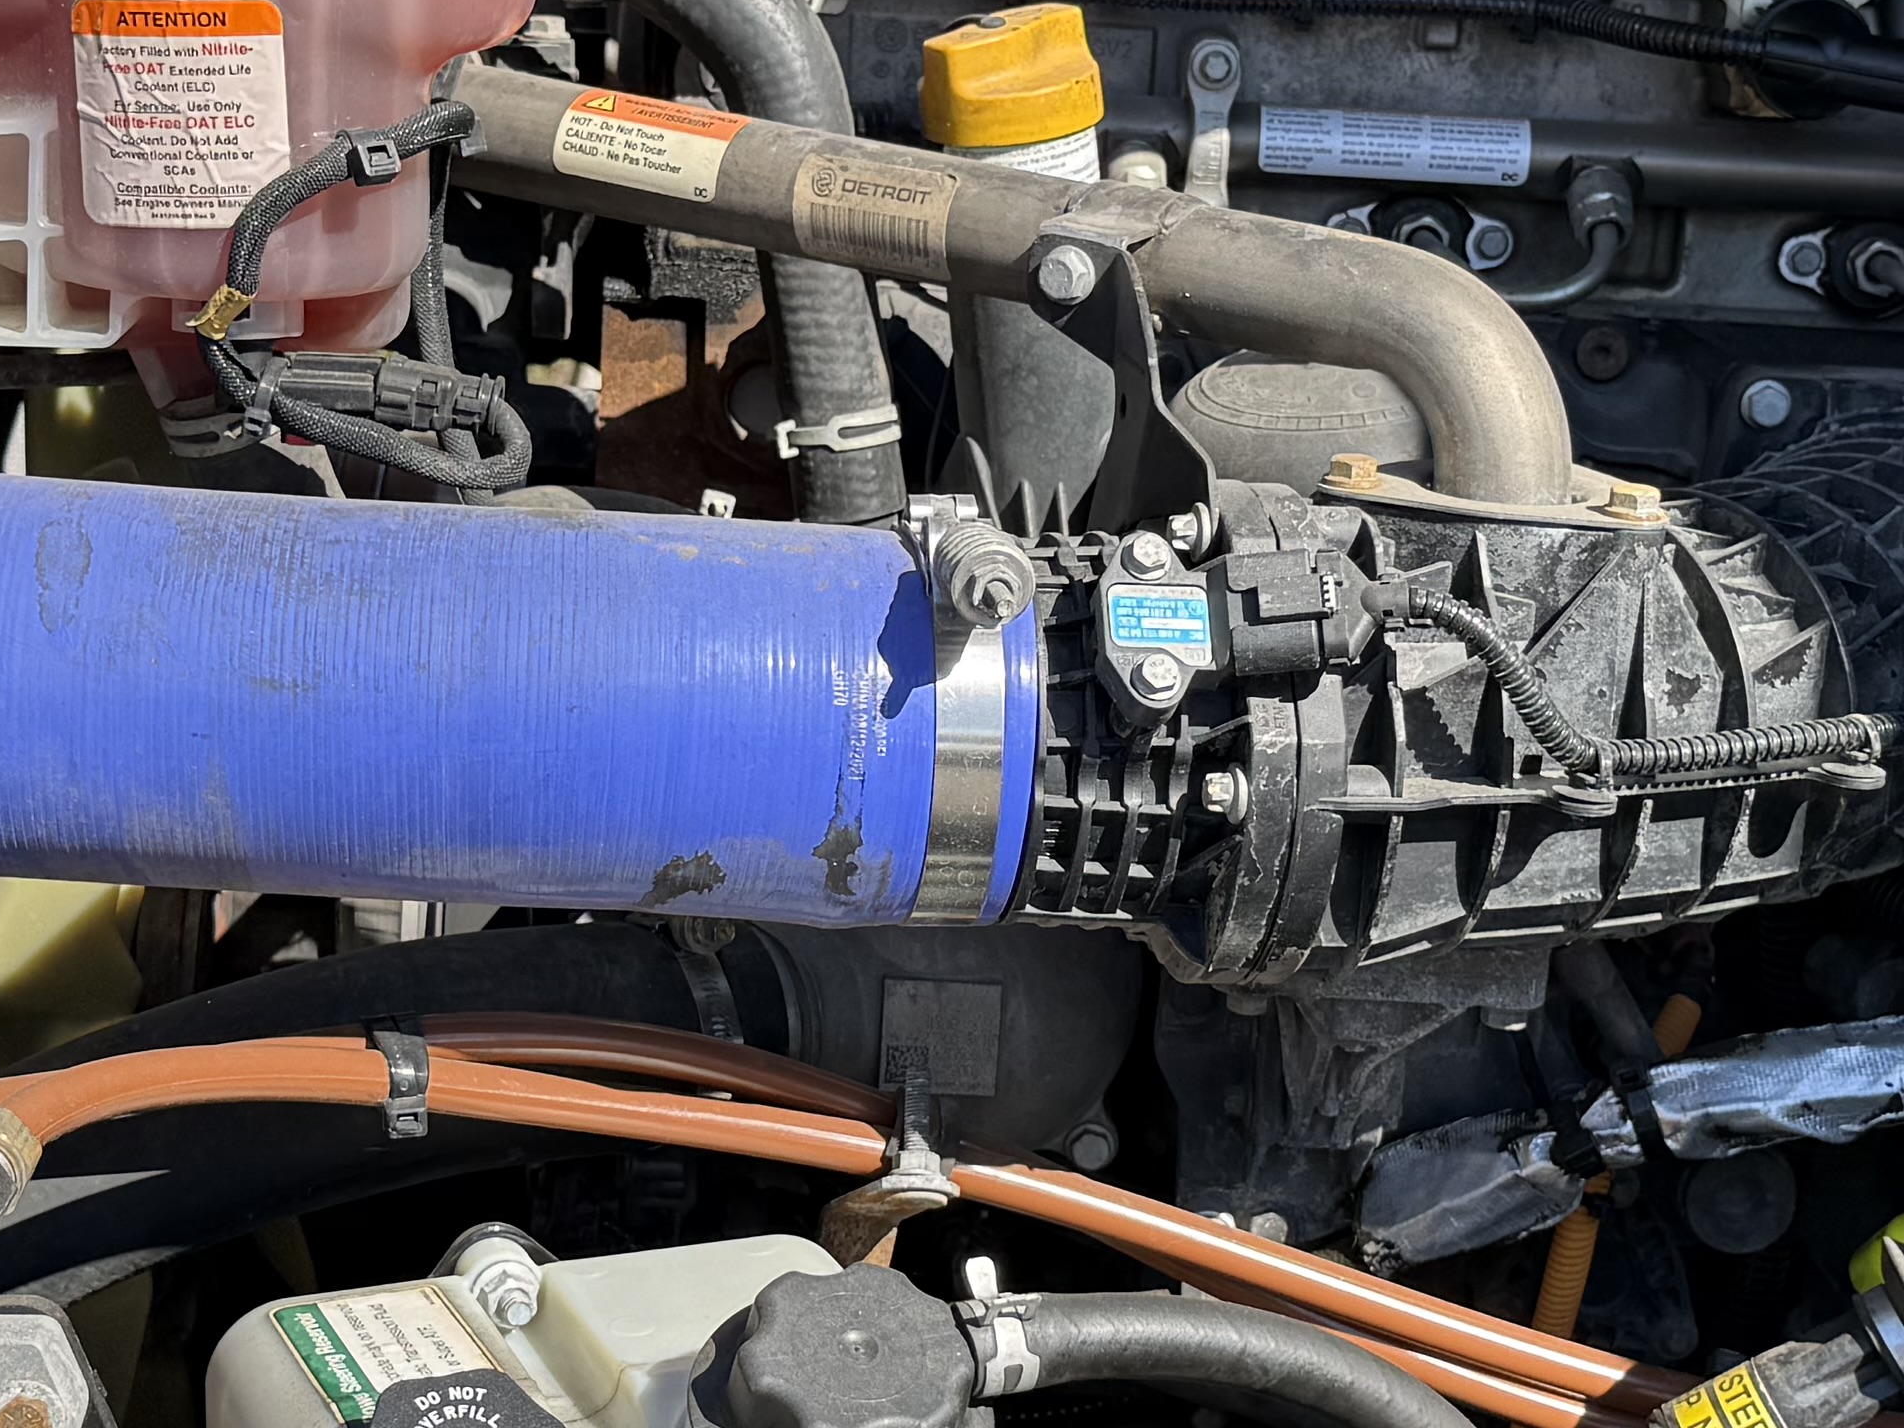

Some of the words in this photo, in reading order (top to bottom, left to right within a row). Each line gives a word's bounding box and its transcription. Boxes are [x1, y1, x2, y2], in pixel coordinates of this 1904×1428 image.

[117, 11, 227, 28] ATTENTION
[140, 45, 171, 57] Filled
[174, 48, 199, 58] with
[202, 43, 254, 57] Nitrite-
[133, 62, 166, 75] OAT
[169, 65, 225, 77] Extended
[229, 64, 252, 75] Life
[134, 81, 179, 93] Coolant
[182, 81, 216, 94] (ELC)
[134, 101, 181, 114] Service:
[187, 102, 211, 113] Use
[213, 101, 242, 114] Only
[186, 116, 222, 129] OAT
[224, 115, 255, 128] ELC
[570, 116, 592, 128] HOT
[600, 121, 614, 132] Do
[615, 124, 634, 136] Not
[636, 127, 666, 142] Touch
[170, 135, 187, 146] Do
[215, 135, 239, 146] Add
[565, 128, 617, 148] CALIENTE
[623, 139, 638, 151] No
[110, 149, 182, 162] Conventional
[186, 150, 239, 162] Coolants
[242, 151, 255, 161] or
[562, 141, 599, 157] CHAUD
[607, 150, 621, 162] Ne
[622, 153, 641, 167] Pas
[643, 156, 683, 175] Toucher
[163, 166, 197, 177] SCAs
[1500, 172, 1520, 183] DC
[117, 183, 186, 196] Compatible
[189, 184, 252, 196] Coolants:
[694, 187, 708, 199] DC
[841, 178, 932, 206] DETROIT
[114, 198, 133, 209] See
[135, 199, 172, 211] Engine
[174, 199, 215, 210] Owners
[293, 1311, 338, 1356] Reservoir
[324, 1352, 363, 1394] Steering
[414, 1390, 441, 1411] DO
[448, 1386, 488, 1402] NOT
